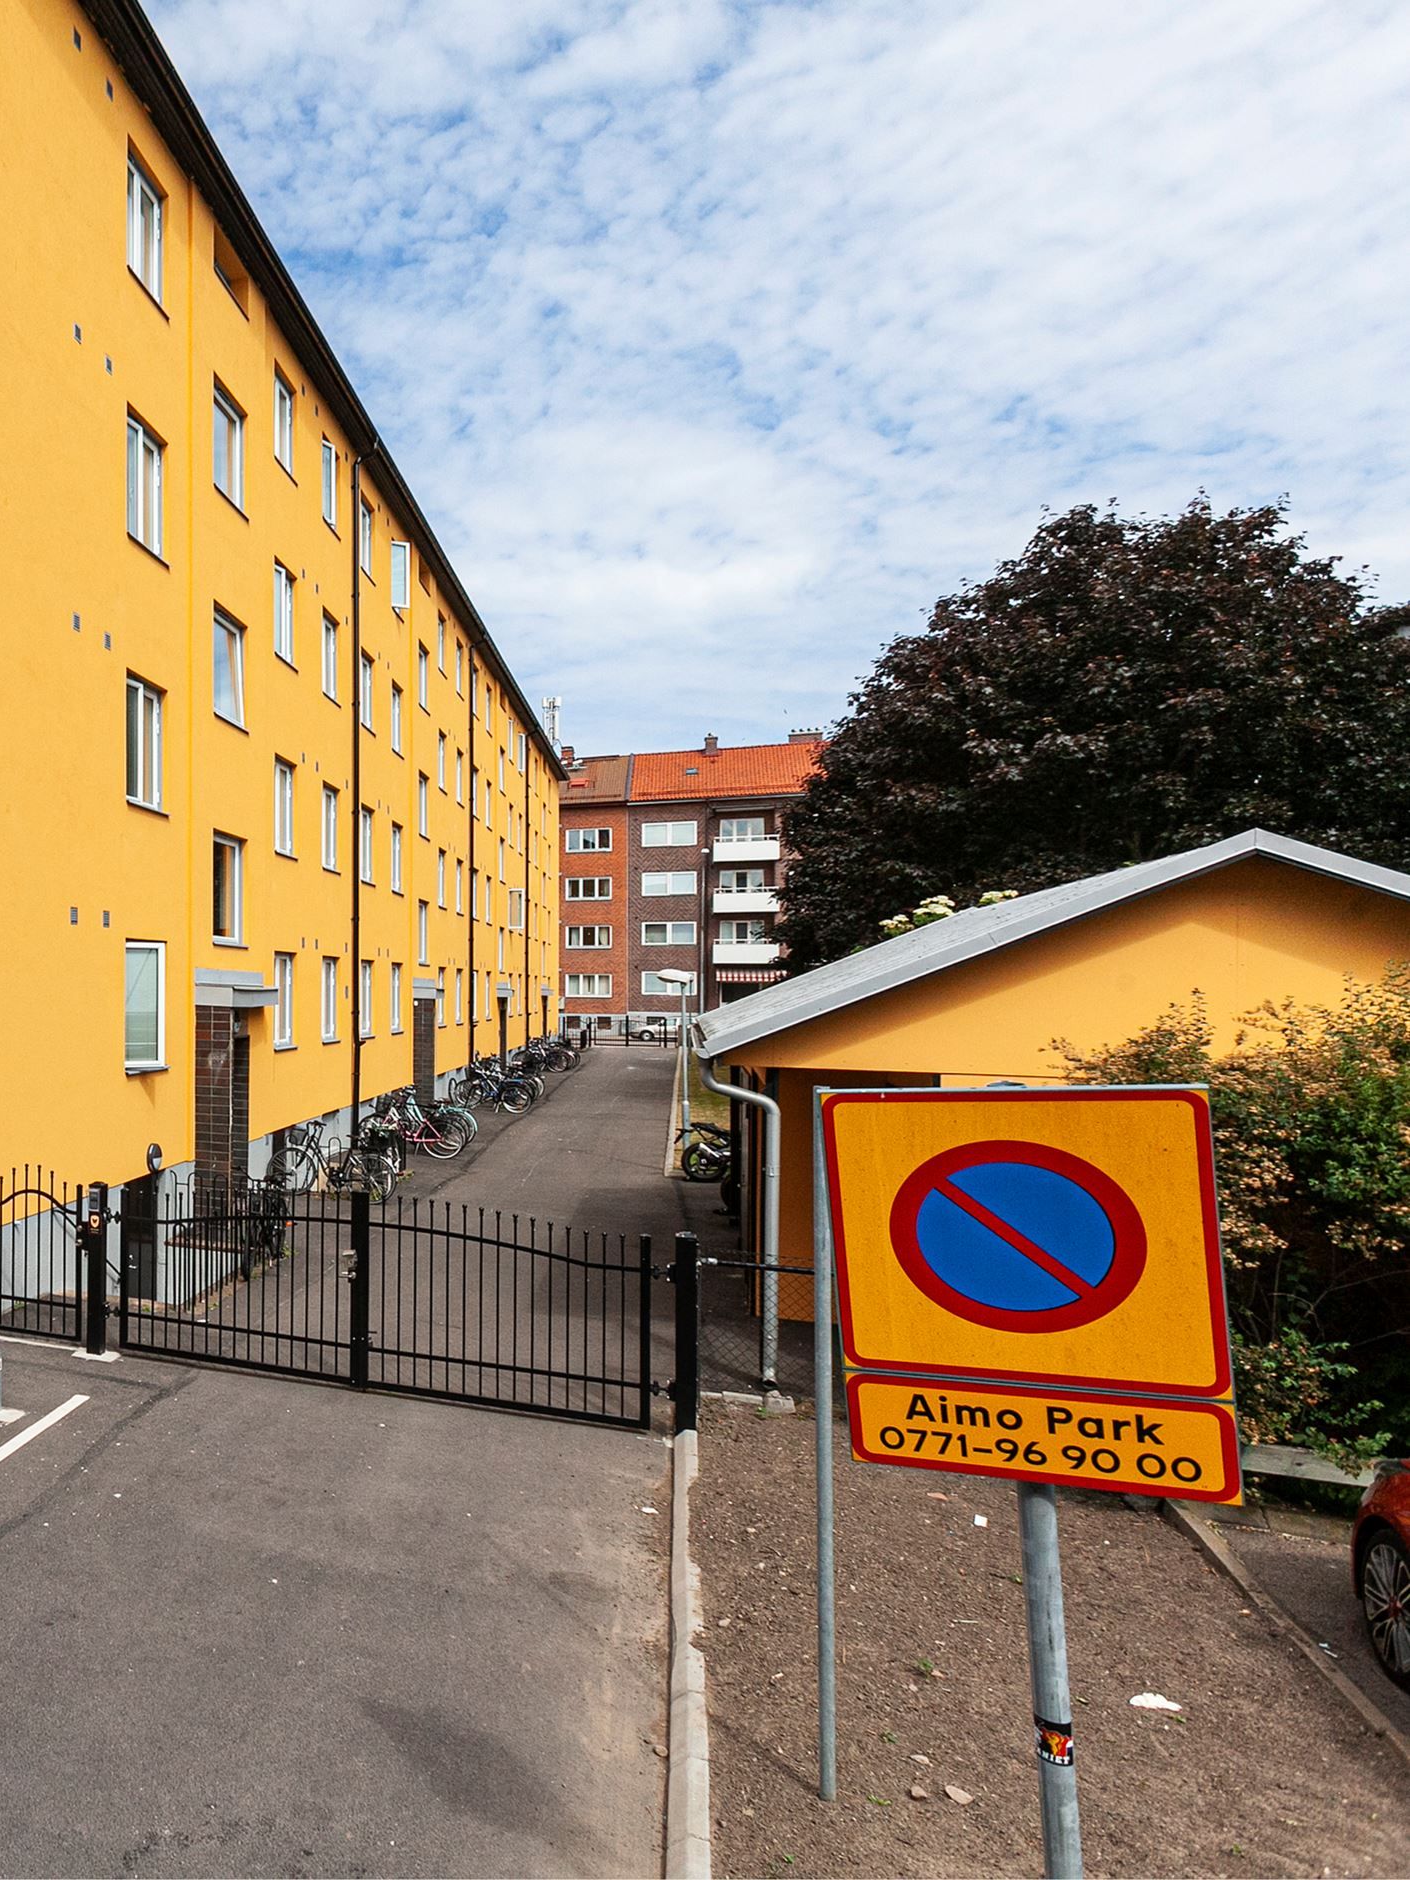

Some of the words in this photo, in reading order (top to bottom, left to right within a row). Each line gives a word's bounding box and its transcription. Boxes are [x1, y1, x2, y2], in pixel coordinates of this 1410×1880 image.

[906, 1393, 1023, 1430] Aimo
[1046, 1406, 1165, 1446] Park
[879, 1426, 1048, 1466] 0771-96
[1061, 1445, 1121, 1474] 90
[1136, 1453, 1203, 1483] 00
